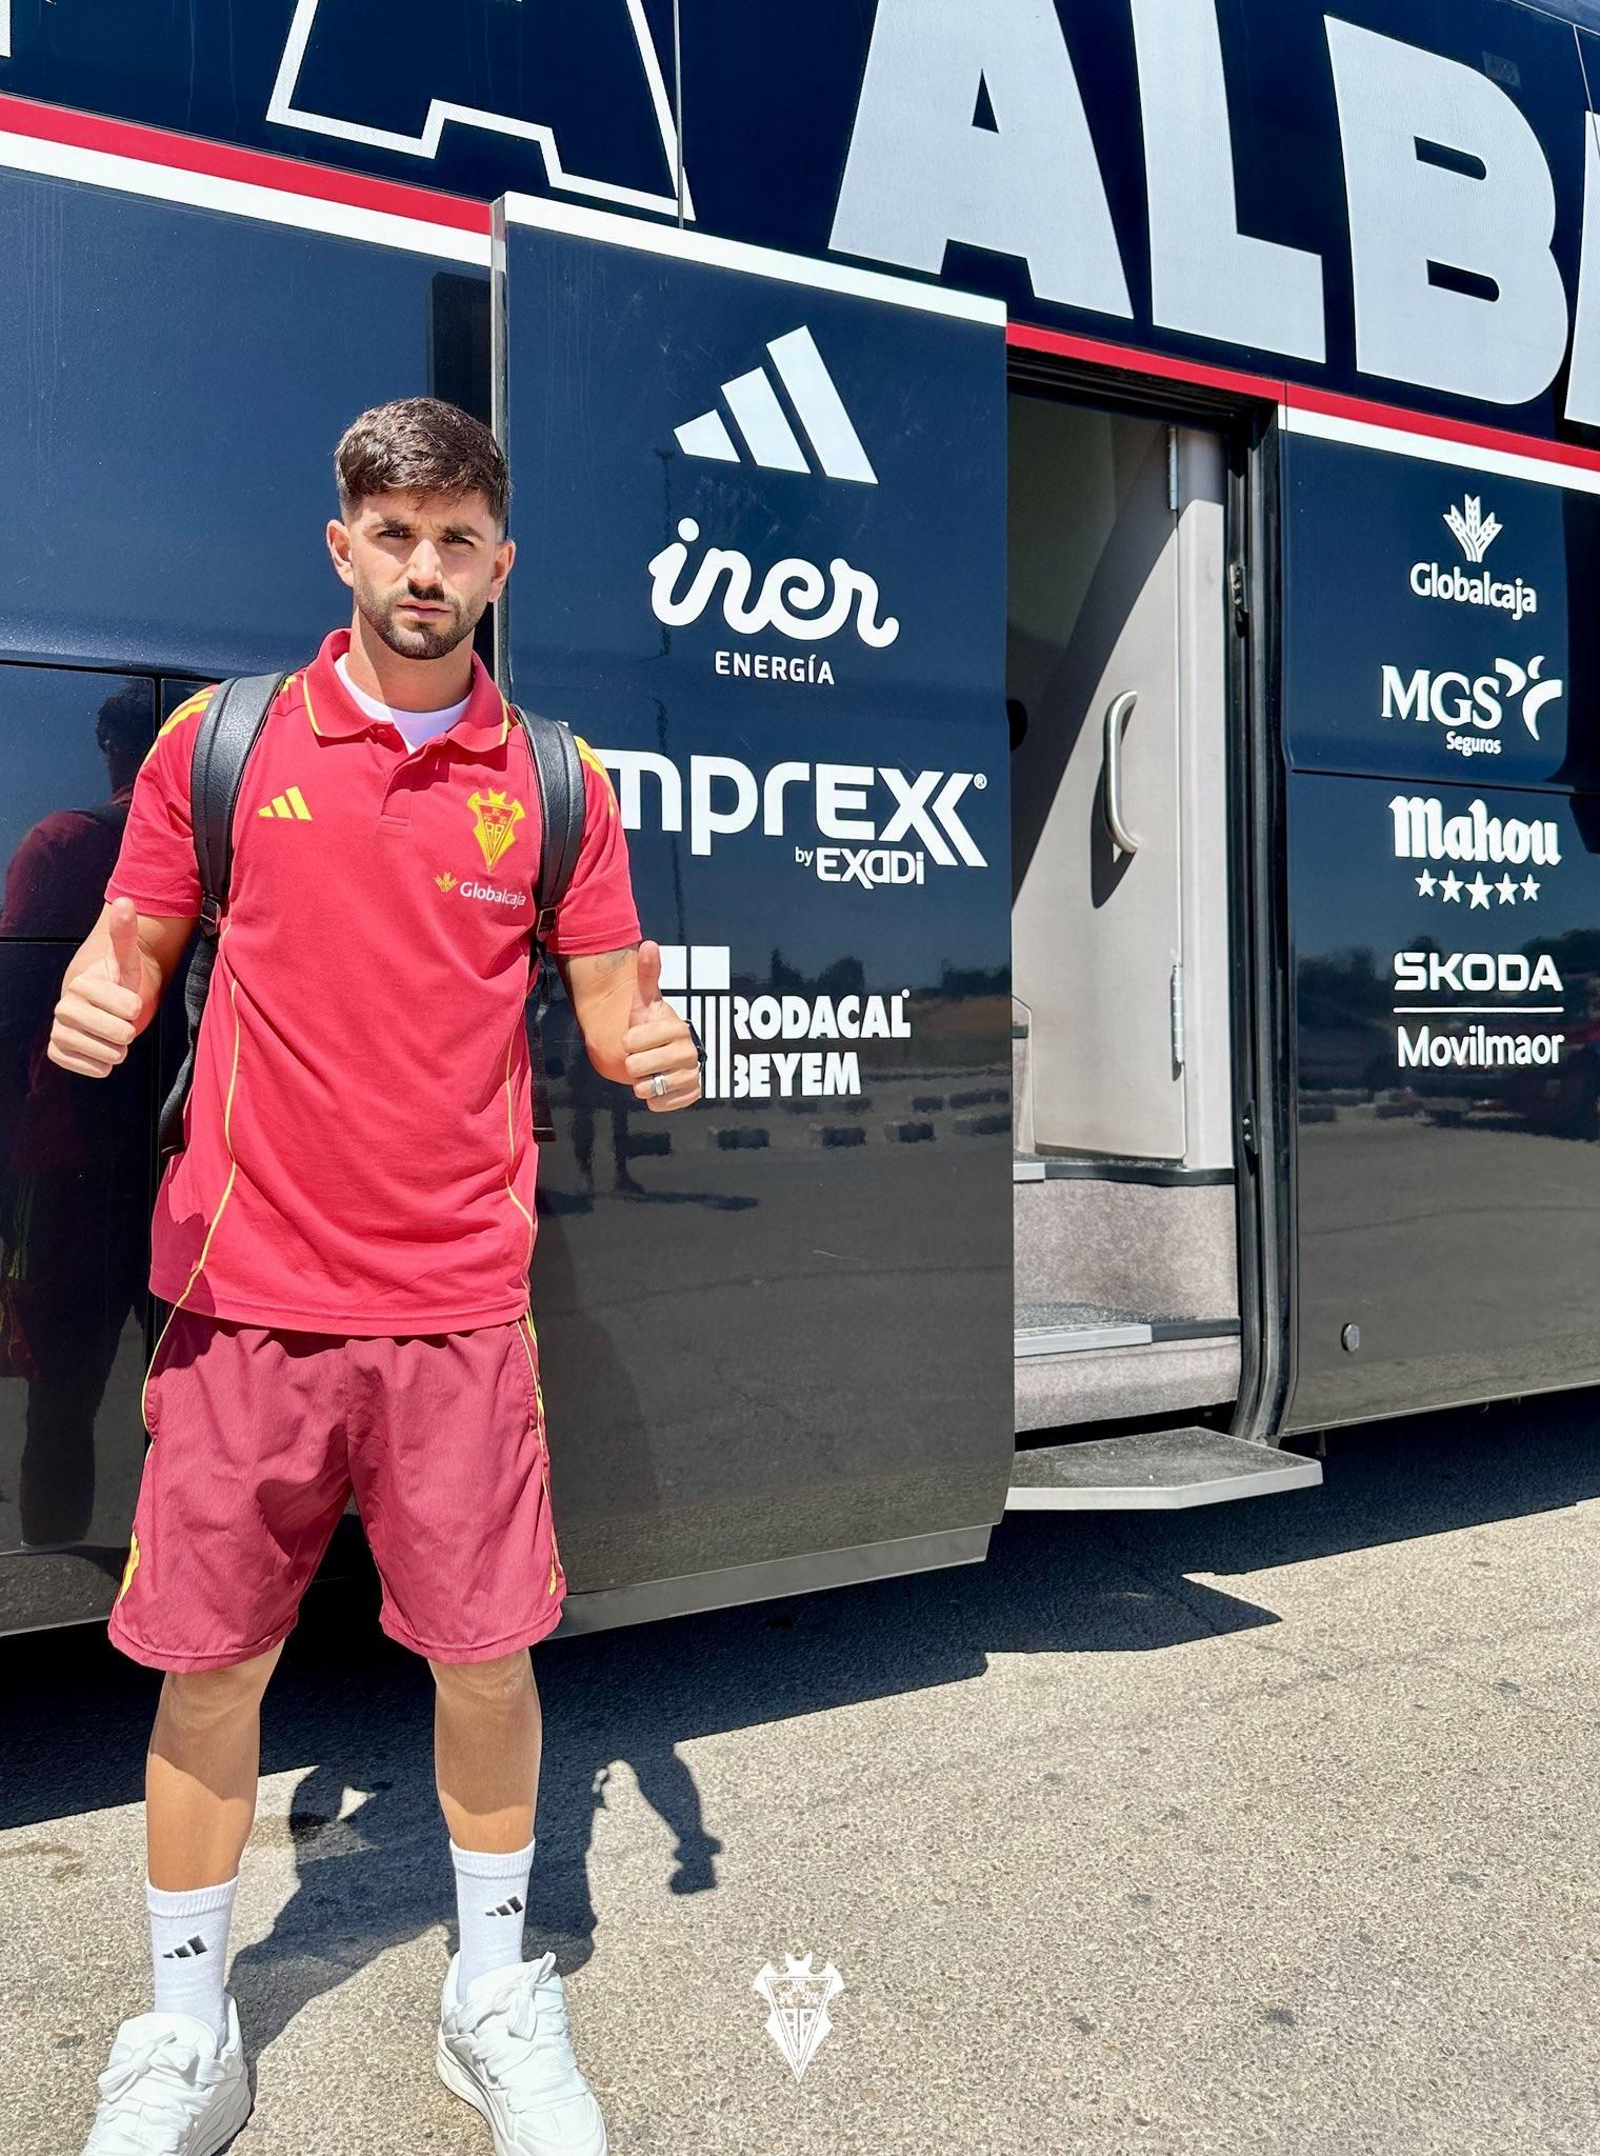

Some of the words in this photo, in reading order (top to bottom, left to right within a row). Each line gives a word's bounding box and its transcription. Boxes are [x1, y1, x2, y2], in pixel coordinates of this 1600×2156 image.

[828, 0, 1600, 428] ALB
[648, 517, 900, 648] iner
[1409, 561, 1538, 621] Globalcaja
[715, 650, 835, 685] ENERGÍA
[1380, 664, 1503, 731] MGS
[1445, 730, 1502, 757] Seguros
[1387, 795, 1563, 866] Mahou
[795, 846, 814, 867] by
[460, 881, 527, 911] Globalcaja
[733, 994, 911, 1040] RODACAL
[1397, 1025, 1565, 1068] Movilmaor
[733, 1051, 862, 1098] BEYEM
